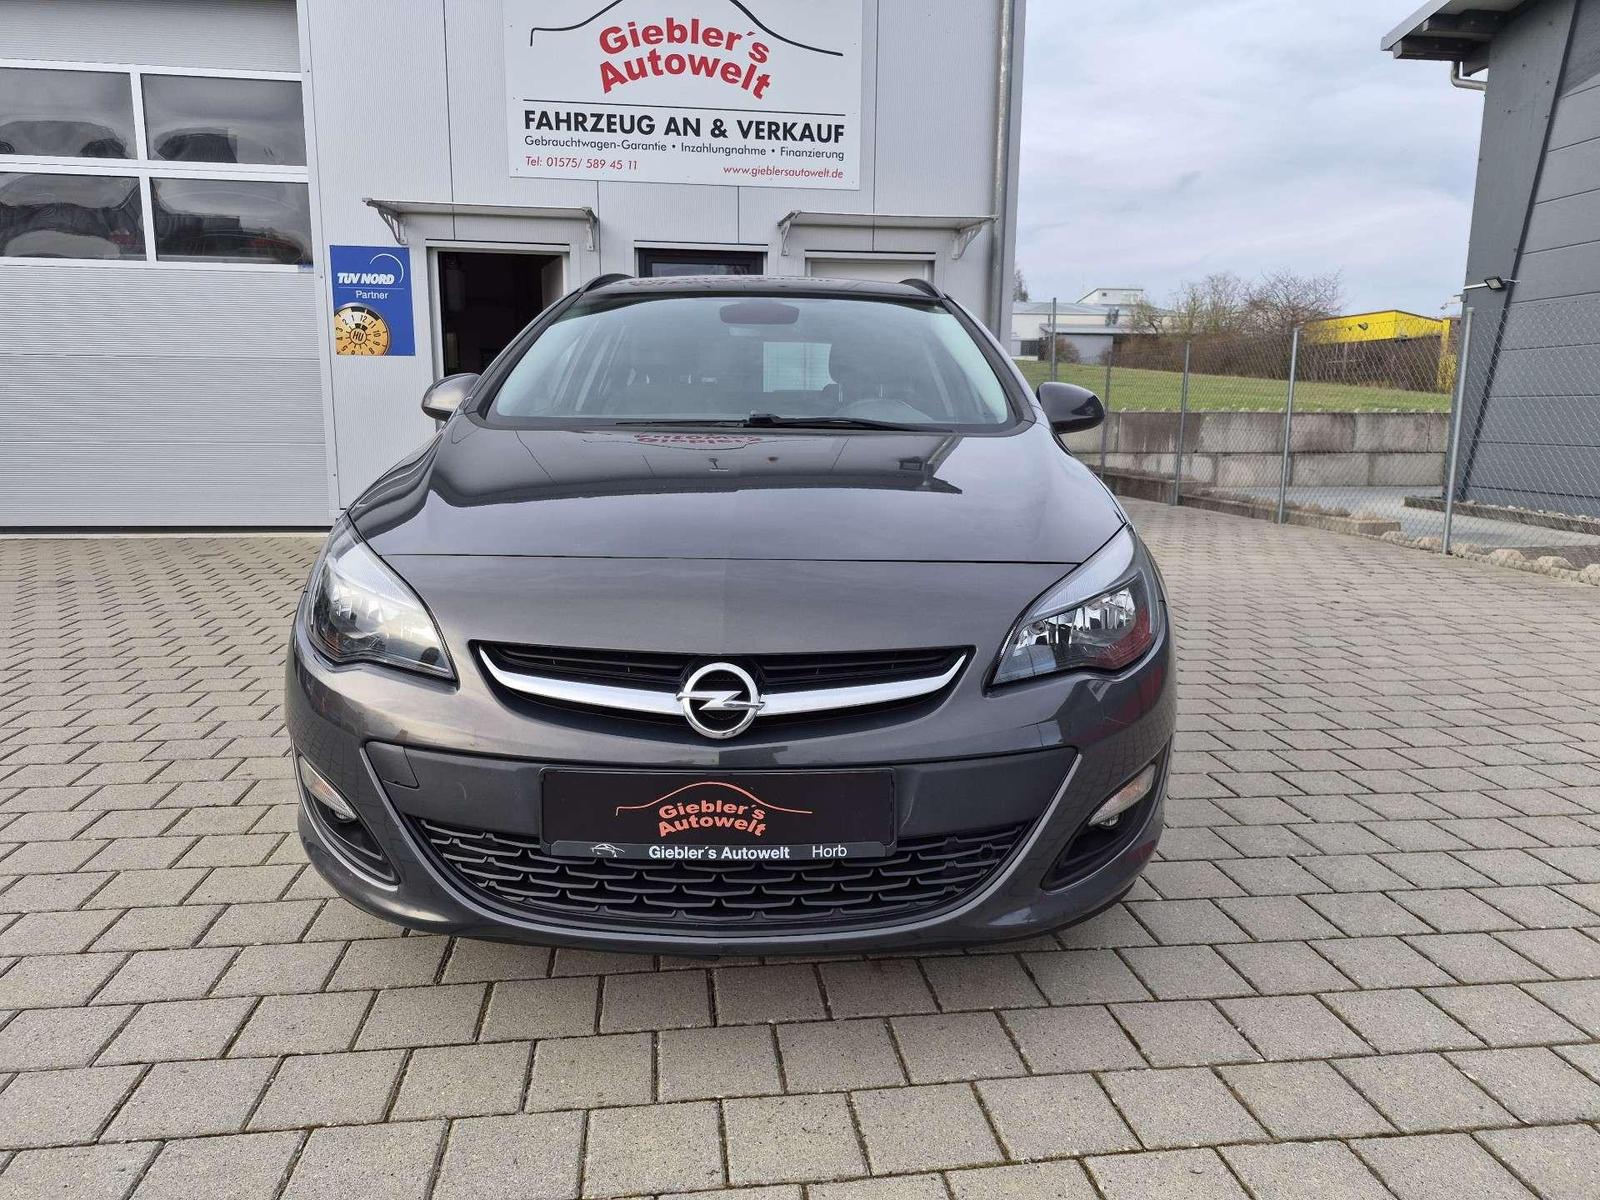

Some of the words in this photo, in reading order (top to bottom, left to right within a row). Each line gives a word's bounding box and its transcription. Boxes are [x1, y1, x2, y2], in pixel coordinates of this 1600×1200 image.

[599, 48, 771, 100] Autowelt
[524, 110, 656, 135] FAHRZEUG
[664, 116, 701, 137] AN
[710, 118, 728, 138] &
[737, 119, 845, 143] VERKAUF
[524, 135, 667, 151] Gebrauchtwagen-Garantie
[681, 142, 766, 156] Inzahlungnahme
[780, 146, 844, 161] Finanzierung
[526, 156, 542, 167] Tel:
[546, 157, 582, 169] 01575/
[586, 158, 606, 169] 589
[609, 160, 623, 170] 45
[628, 160, 638, 170] 11
[723, 165, 844, 178] www.gieblersautowelt.de
[361, 273, 395, 285] NORD
[355, 290, 389, 300] Partner
[352, 330, 364, 342] HU
[658, 815, 767, 837] Autowelt
[721, 846, 790, 860] Autowelt
[812, 844, 847, 858] Horb
